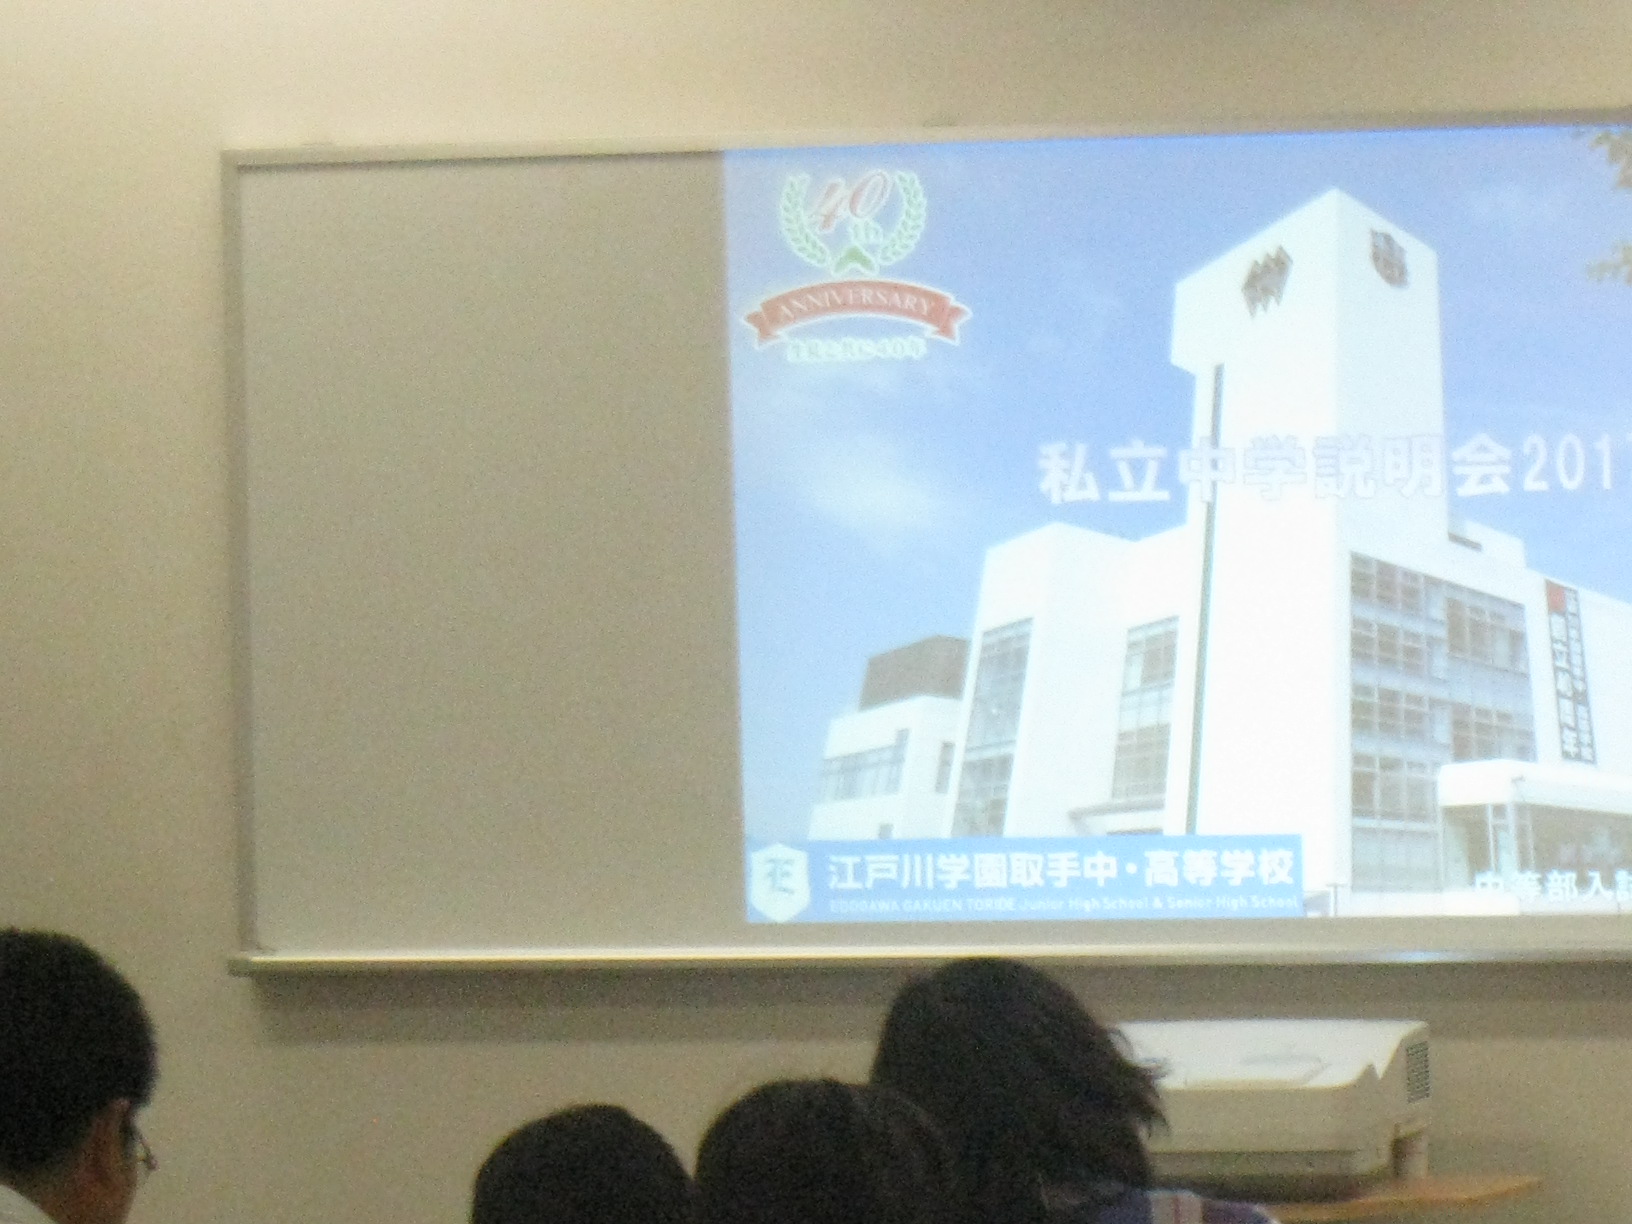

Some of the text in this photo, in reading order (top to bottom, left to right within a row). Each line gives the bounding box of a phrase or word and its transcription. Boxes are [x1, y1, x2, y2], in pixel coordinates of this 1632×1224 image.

[780, 287, 932, 318] ANNIVERSARY
[828, 848, 1295, 890] 江戸川学園取手中・高等学校
[903, 898, 963, 914] GAKUEN
[967, 897, 1016, 912] TORIDE
[1019, 896, 1063, 912] Junior
[1066, 895, 1099, 914] High
[1102, 895, 1148, 911] School
[1167, 895, 1211, 910] Senior
[1214, 893, 1248, 912] High
[1251, 893, 1298, 910] School
